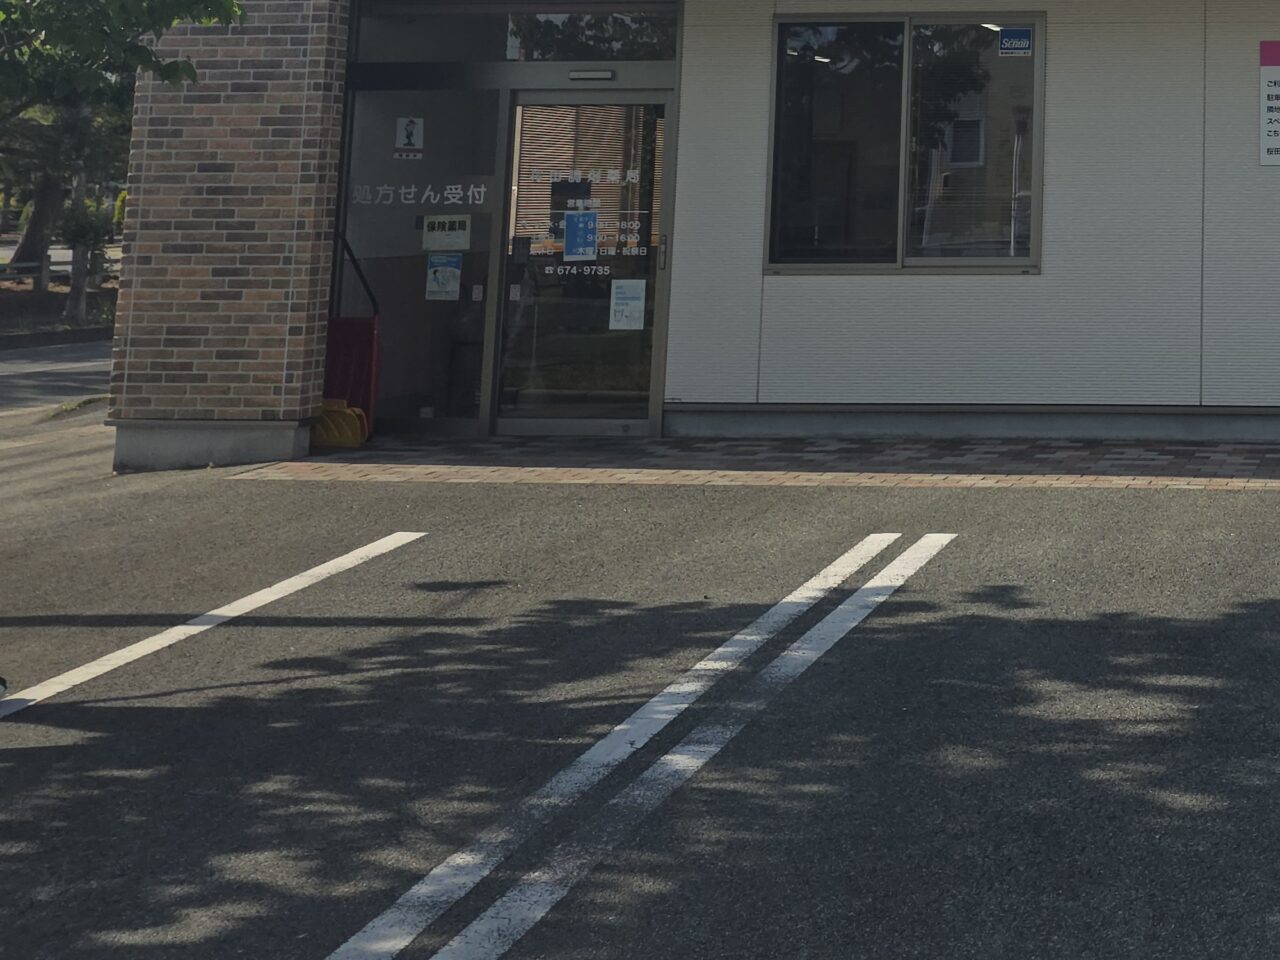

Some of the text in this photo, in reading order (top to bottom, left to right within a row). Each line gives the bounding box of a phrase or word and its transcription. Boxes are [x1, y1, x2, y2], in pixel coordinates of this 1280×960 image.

[352, 183, 488, 206] 処方せん受付
[426, 220, 468, 233] 保険薬局
